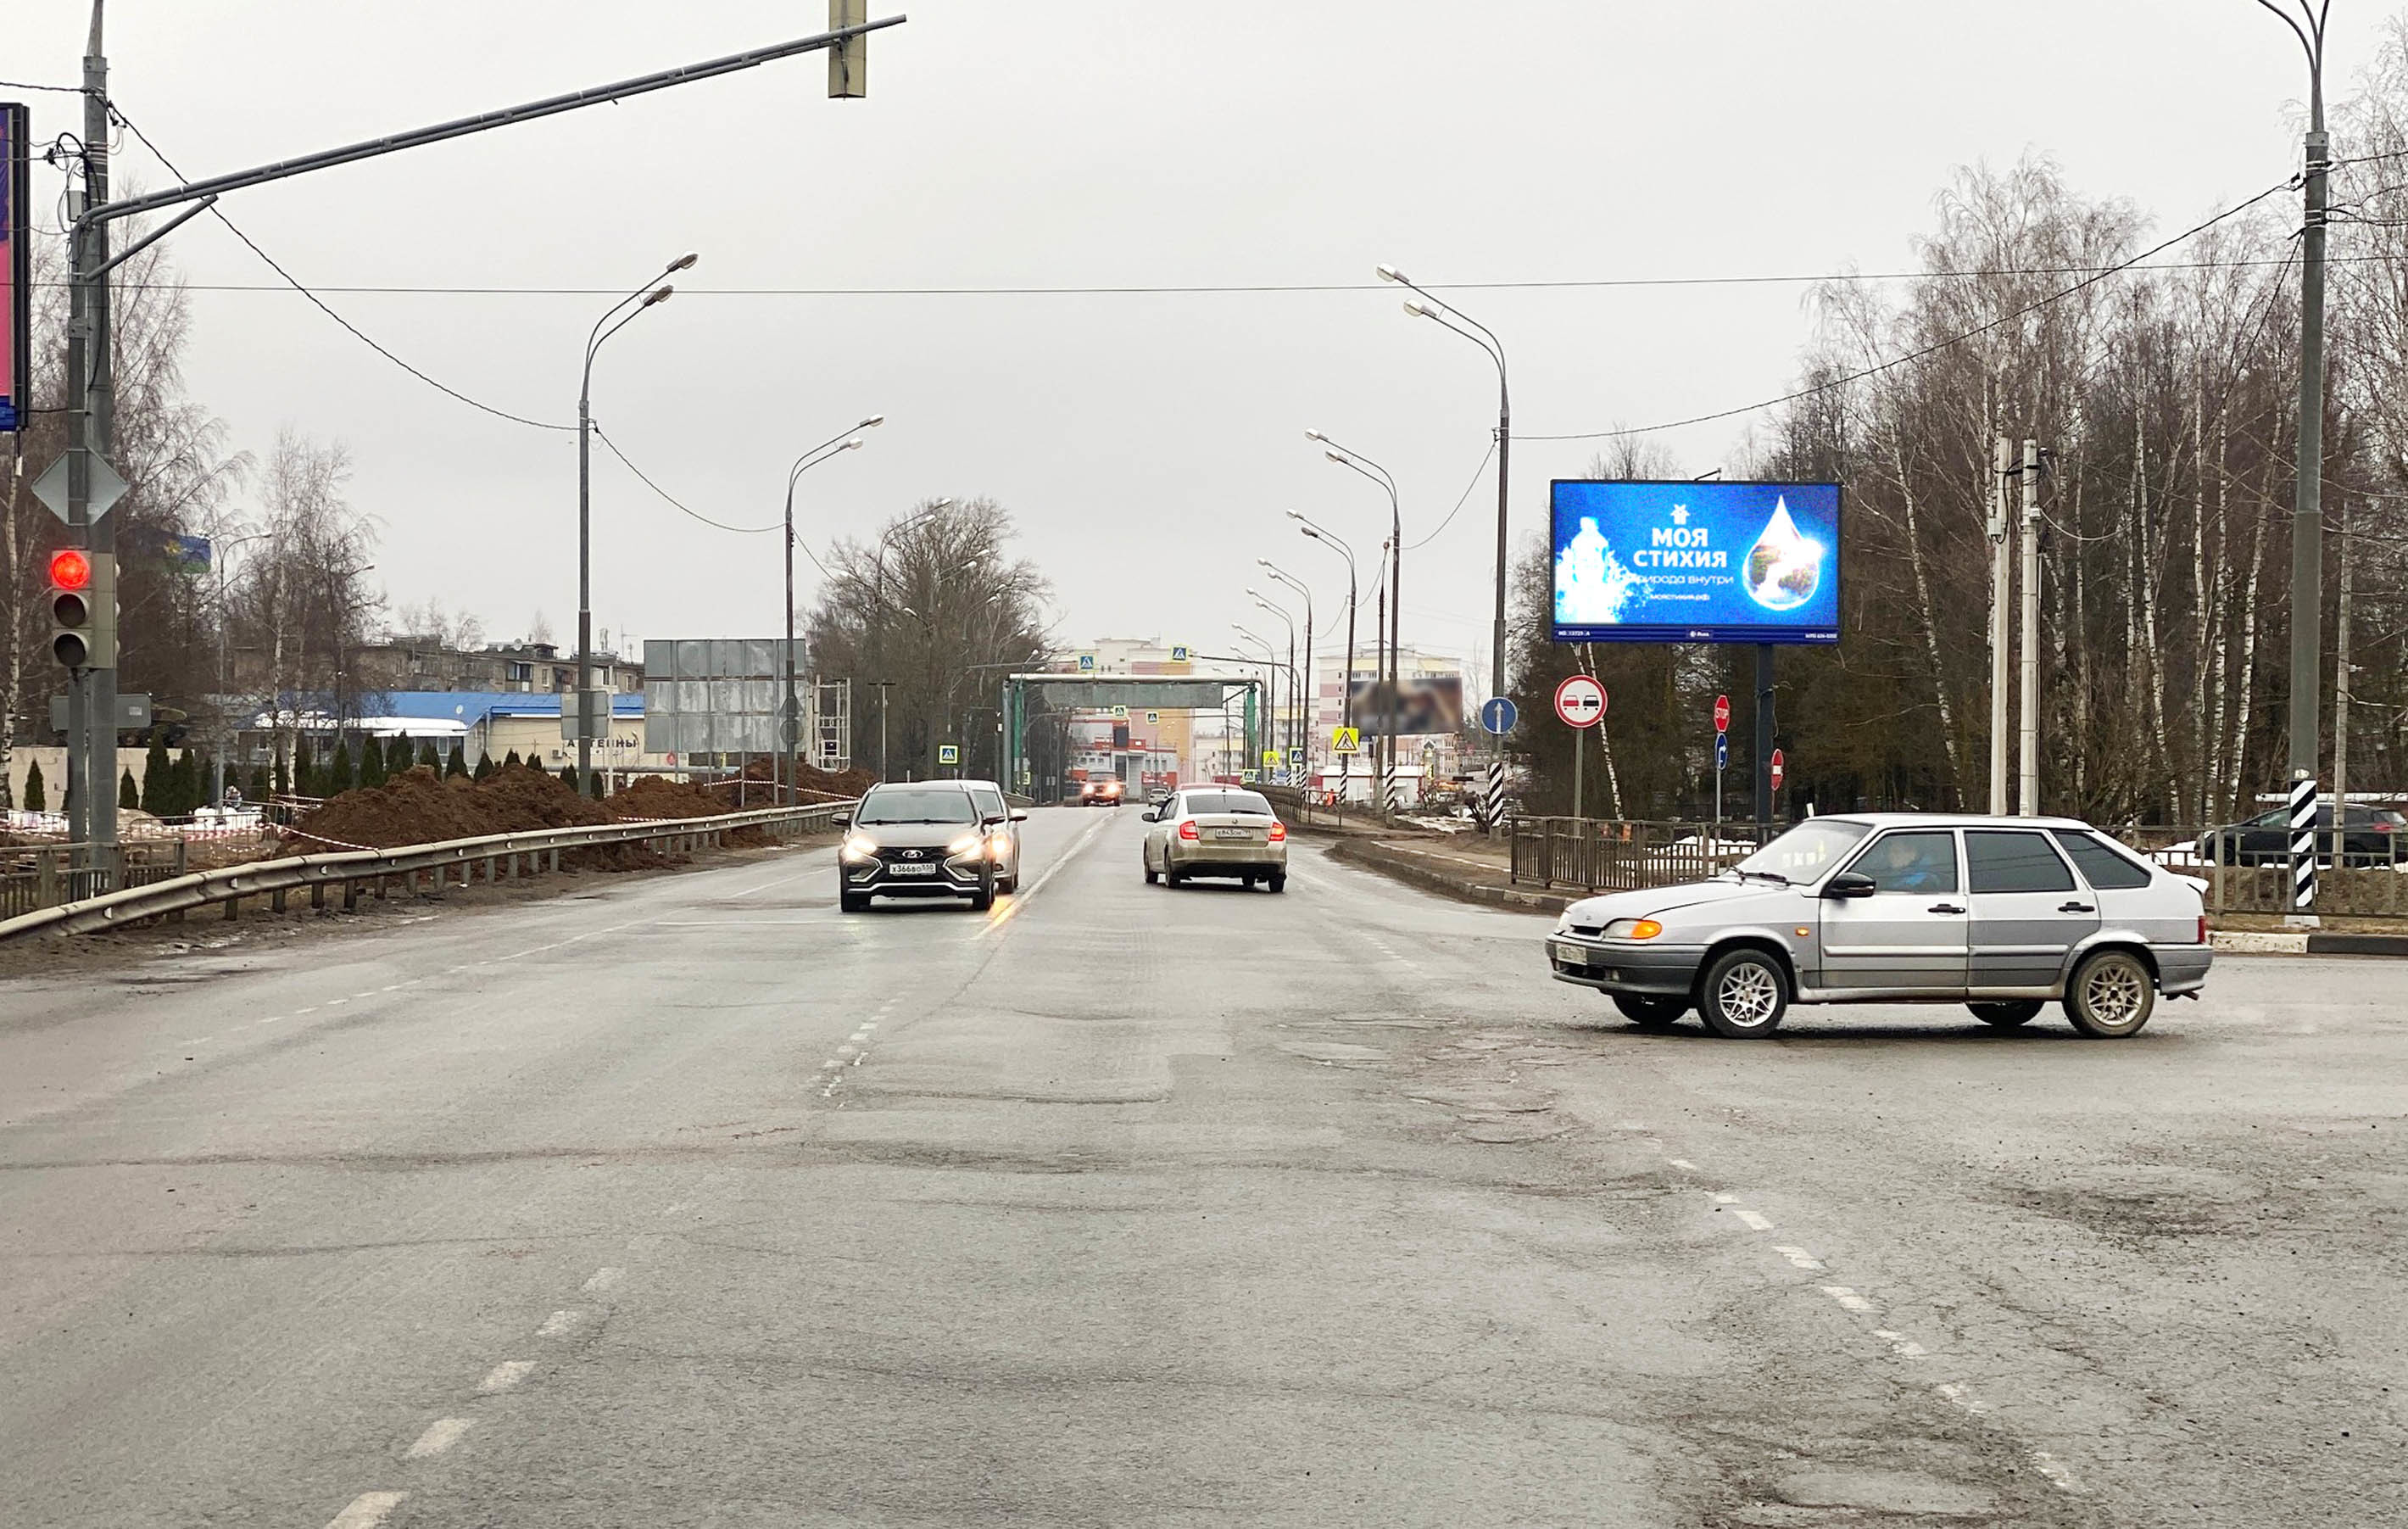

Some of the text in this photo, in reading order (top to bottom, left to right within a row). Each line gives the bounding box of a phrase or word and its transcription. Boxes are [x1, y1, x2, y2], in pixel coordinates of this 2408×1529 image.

[1652, 527, 1708, 548] МОЯ
[1633, 550, 1727, 567] СТИХИЯ
[1634, 575, 1735, 586] рирода внутри
[1715, 707, 1730, 720] STOP
[567, 739, 637, 748] АТЕННЫ
